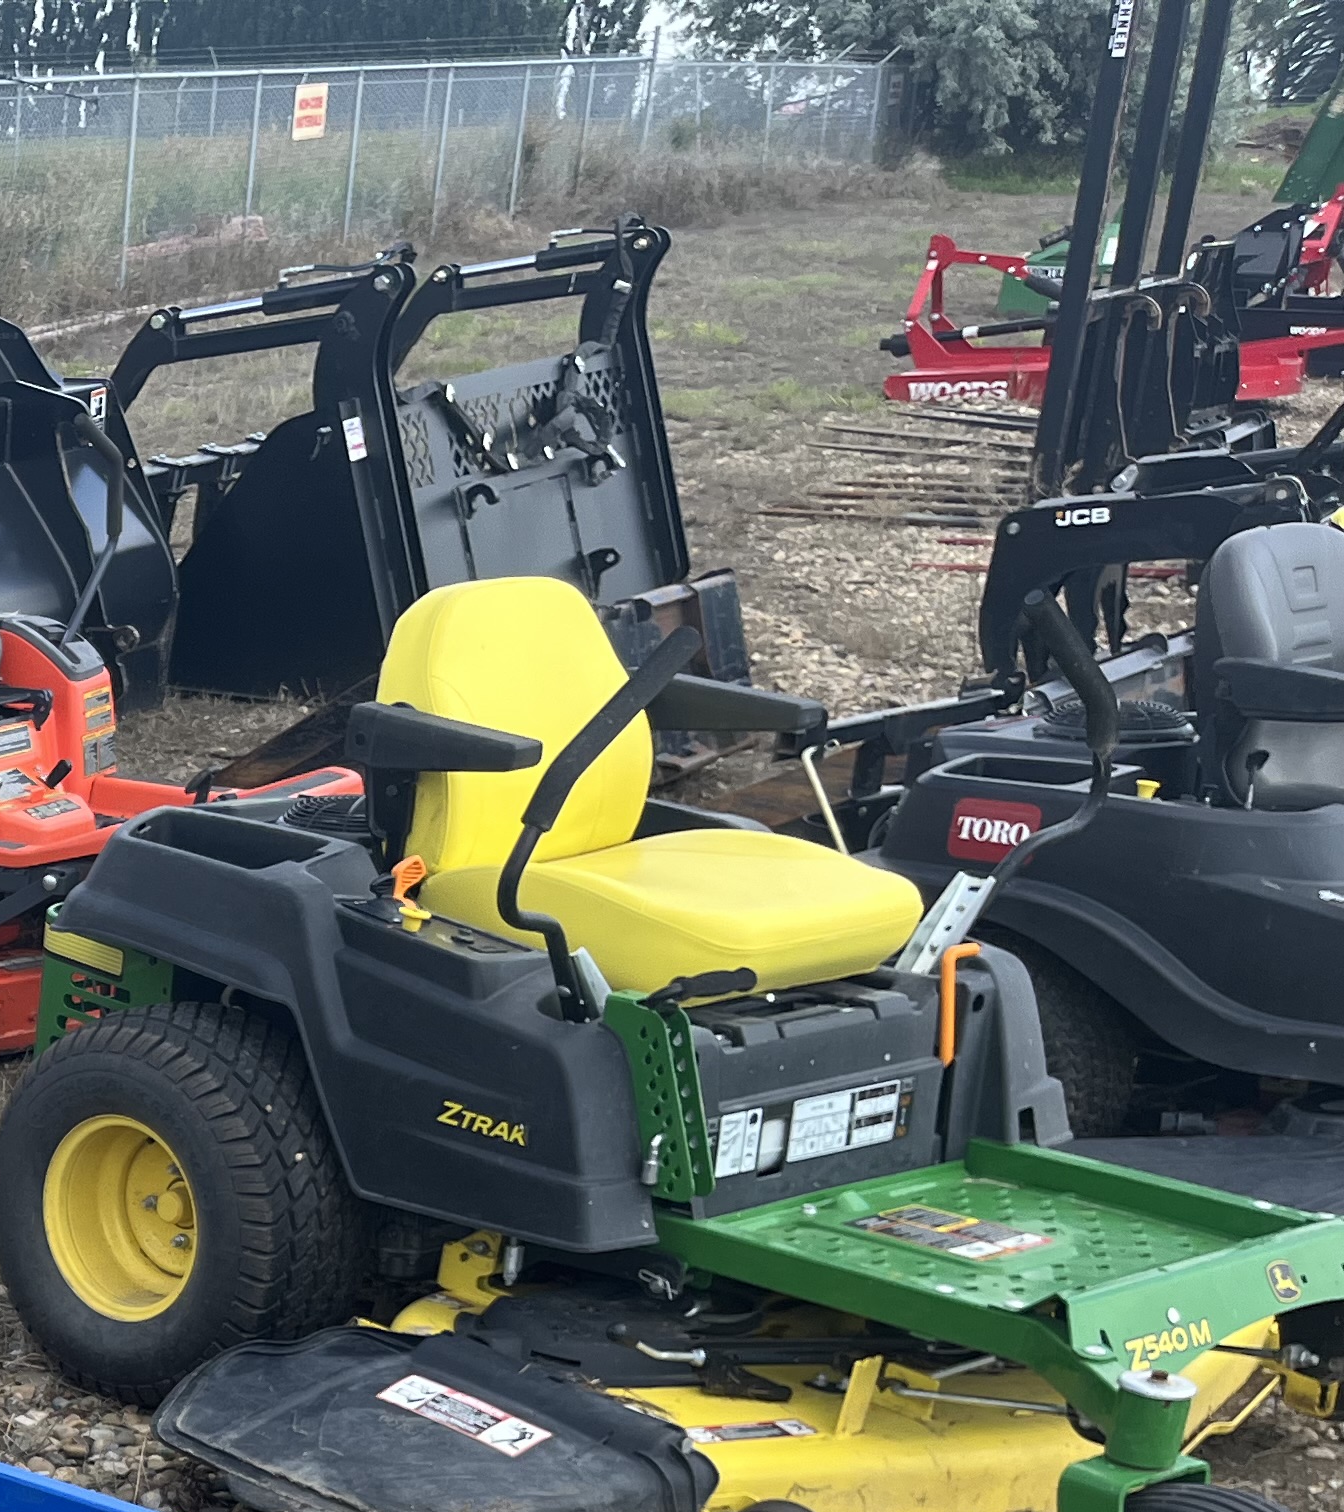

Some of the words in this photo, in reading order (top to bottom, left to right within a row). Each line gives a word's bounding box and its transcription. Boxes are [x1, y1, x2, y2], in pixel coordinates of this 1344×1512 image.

[908, 381, 1008, 402] WOODS
[1055, 507, 1111, 527] JCB
[957, 815, 1031, 848] TORO
[436, 1100, 527, 1147] ZTRAK
